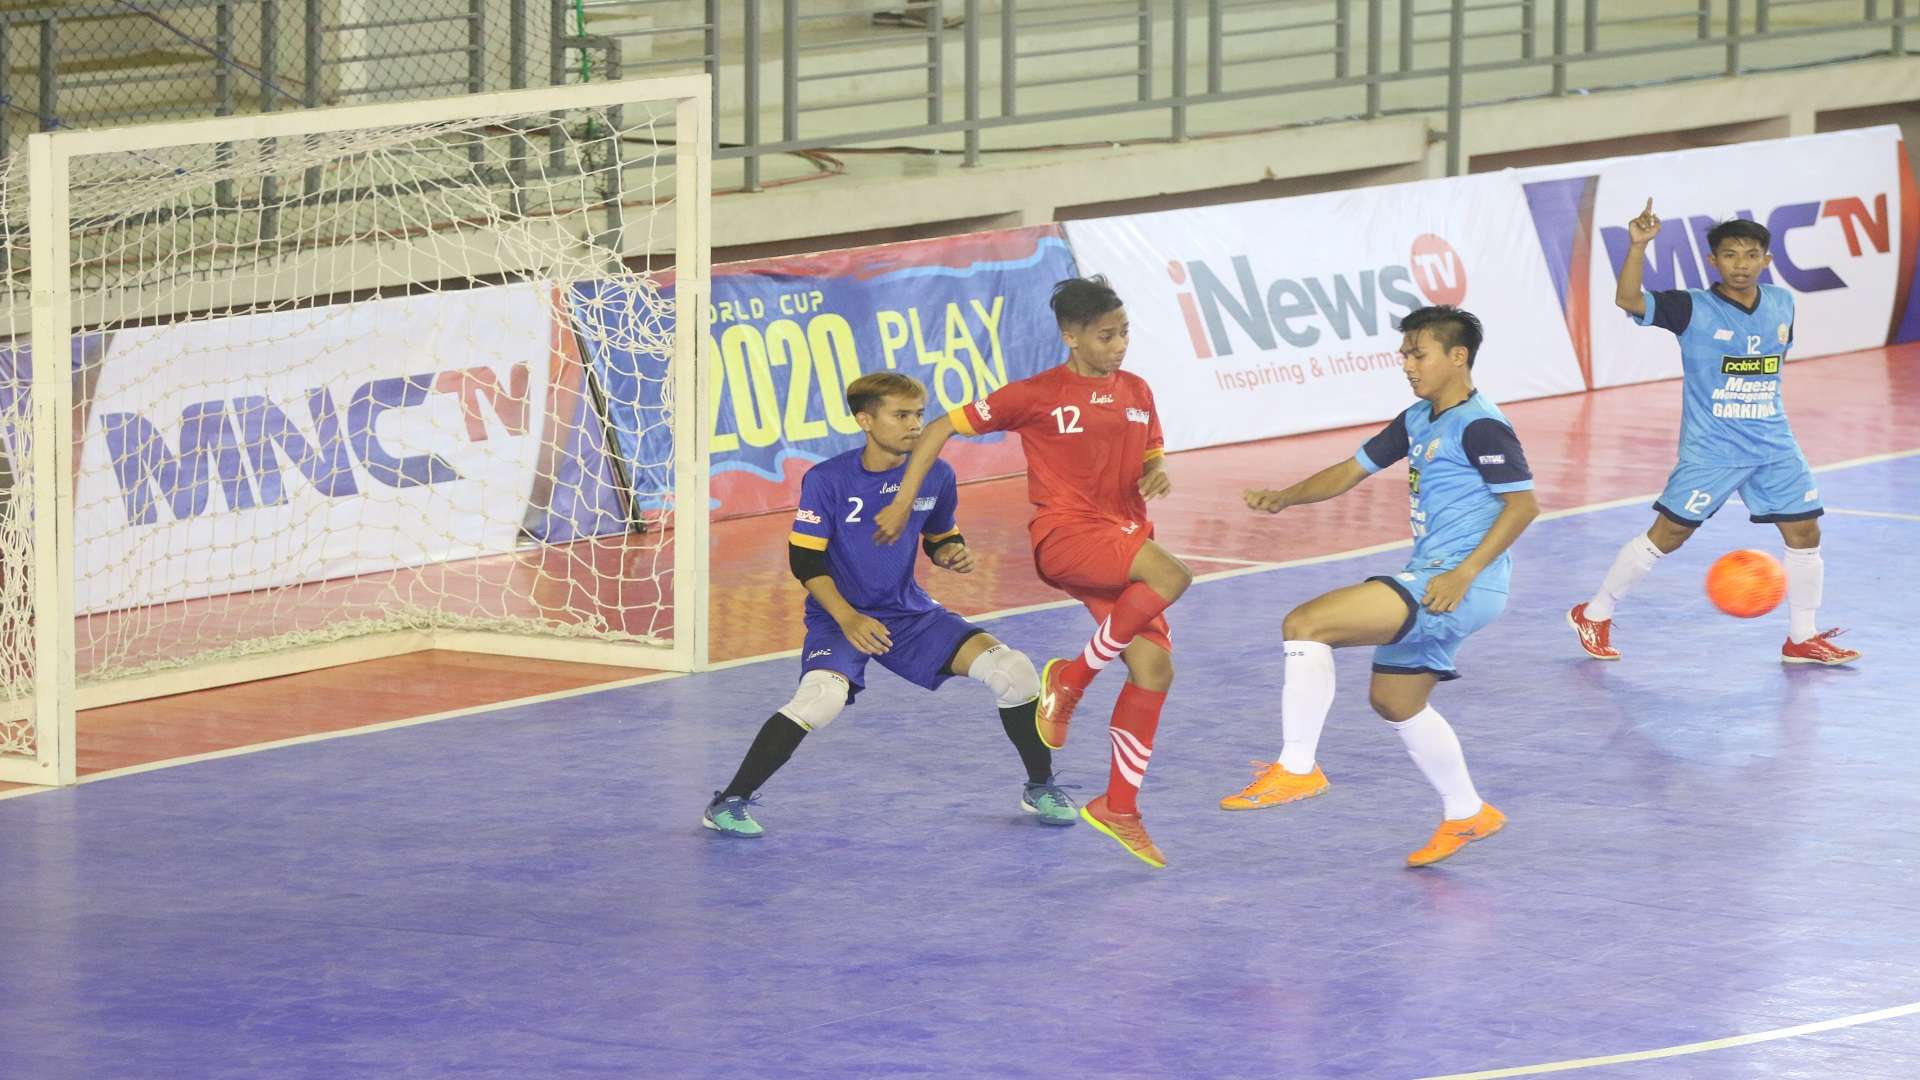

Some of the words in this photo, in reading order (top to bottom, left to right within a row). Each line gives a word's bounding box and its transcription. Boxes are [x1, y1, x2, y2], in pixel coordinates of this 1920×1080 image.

[779, 290, 824, 316] CUP
[1167, 255, 1423, 359] iNews
[1416, 252, 1454, 291] TV
[876, 296, 1006, 370] PLAY
[1747, 335, 1761, 355] 12
[1215, 362, 1305, 391] Inspiring
[1311, 359, 1324, 377] &
[1725, 359, 1761, 373] patriot
[934, 350, 1009, 412] ON
[1725, 376, 1777, 393] Maesa
[1050, 405, 1084, 434] 12
[100, 373, 465, 526] MNC
[845, 496, 864, 523] 2
[1684, 489, 1712, 514] 12
